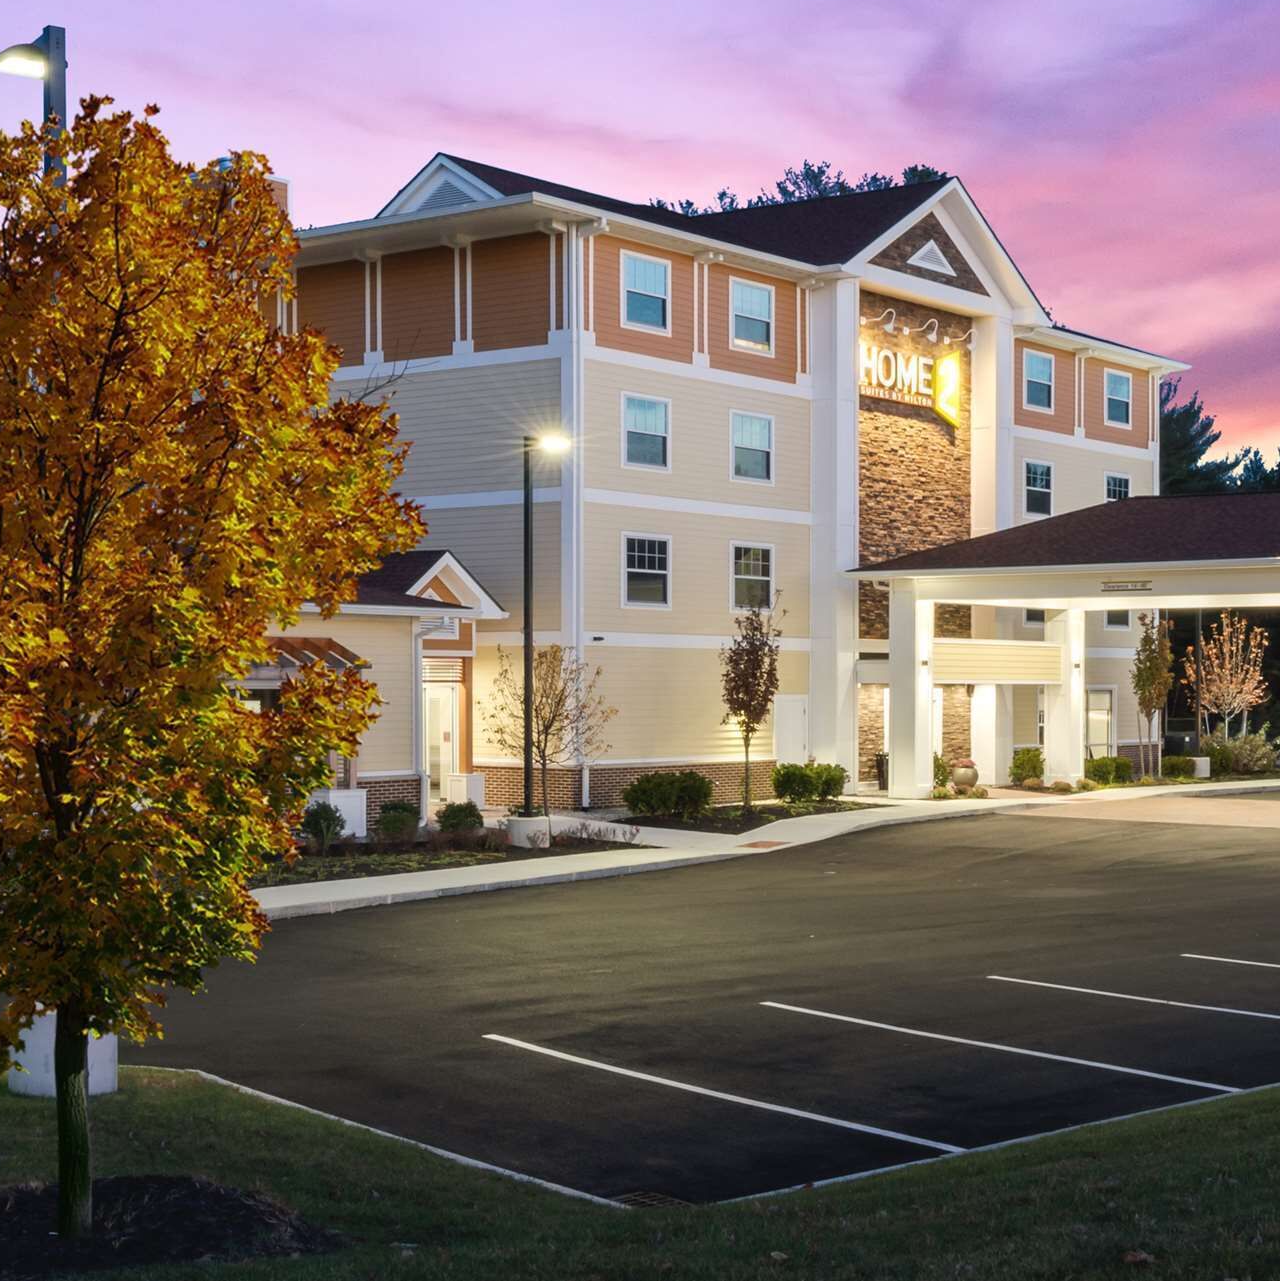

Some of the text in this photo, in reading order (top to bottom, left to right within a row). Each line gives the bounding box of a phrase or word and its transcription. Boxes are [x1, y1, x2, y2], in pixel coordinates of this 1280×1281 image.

[859, 344, 958, 419] HOME 2
[860, 386, 890, 399] SUITES
[904, 393, 933, 407] HILTON
